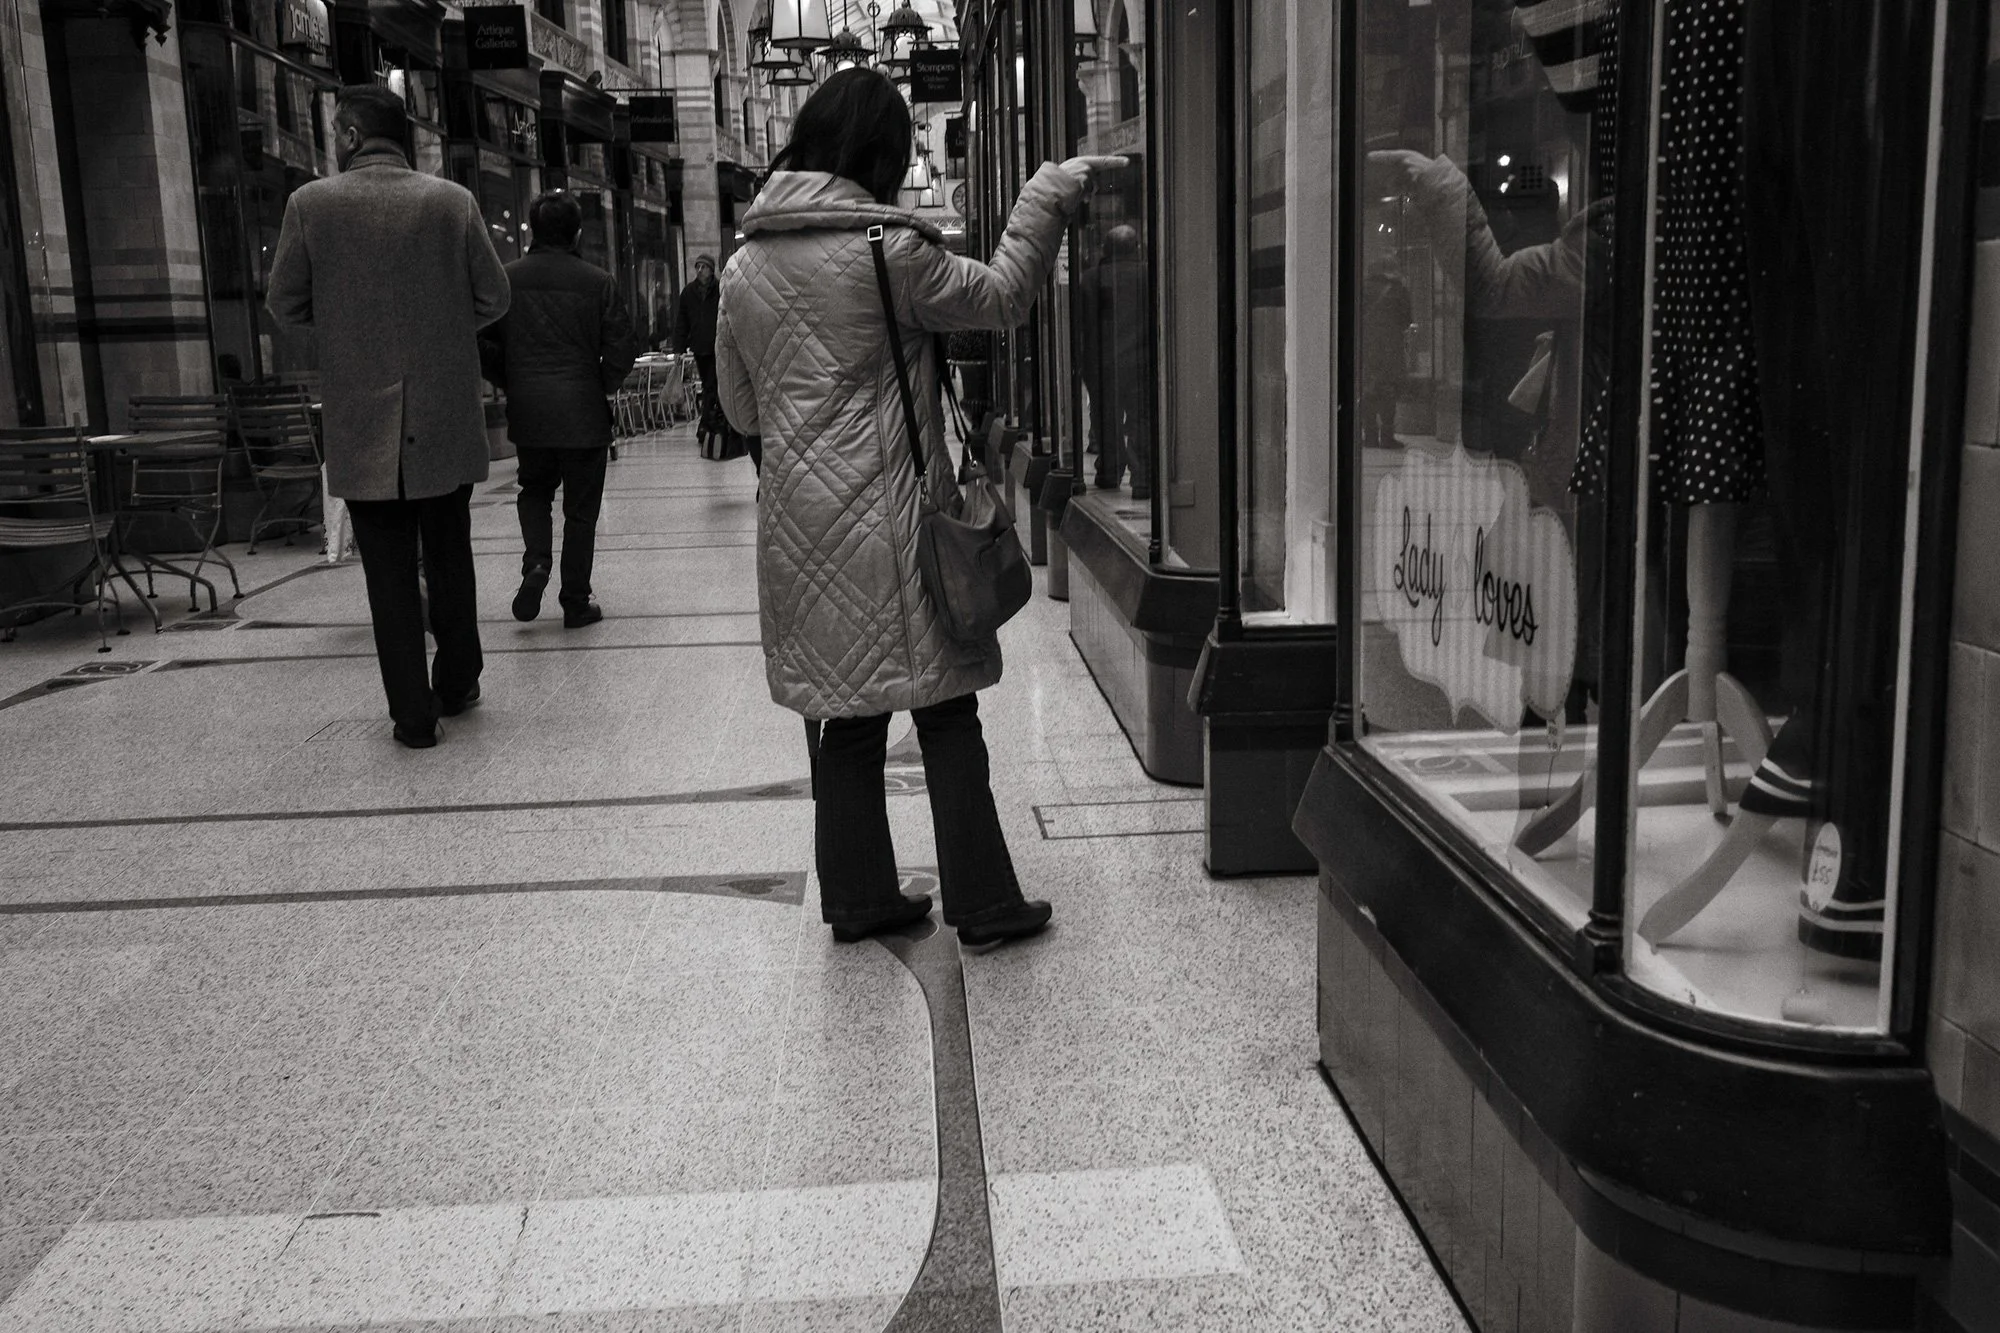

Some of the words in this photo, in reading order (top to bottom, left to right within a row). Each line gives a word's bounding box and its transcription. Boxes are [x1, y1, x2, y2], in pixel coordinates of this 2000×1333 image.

[475, 36, 518, 50] Galleries
[916, 62, 955, 74] Stompers
[1393, 505, 1447, 646] Lady
[1473, 525, 1539, 646] loves
